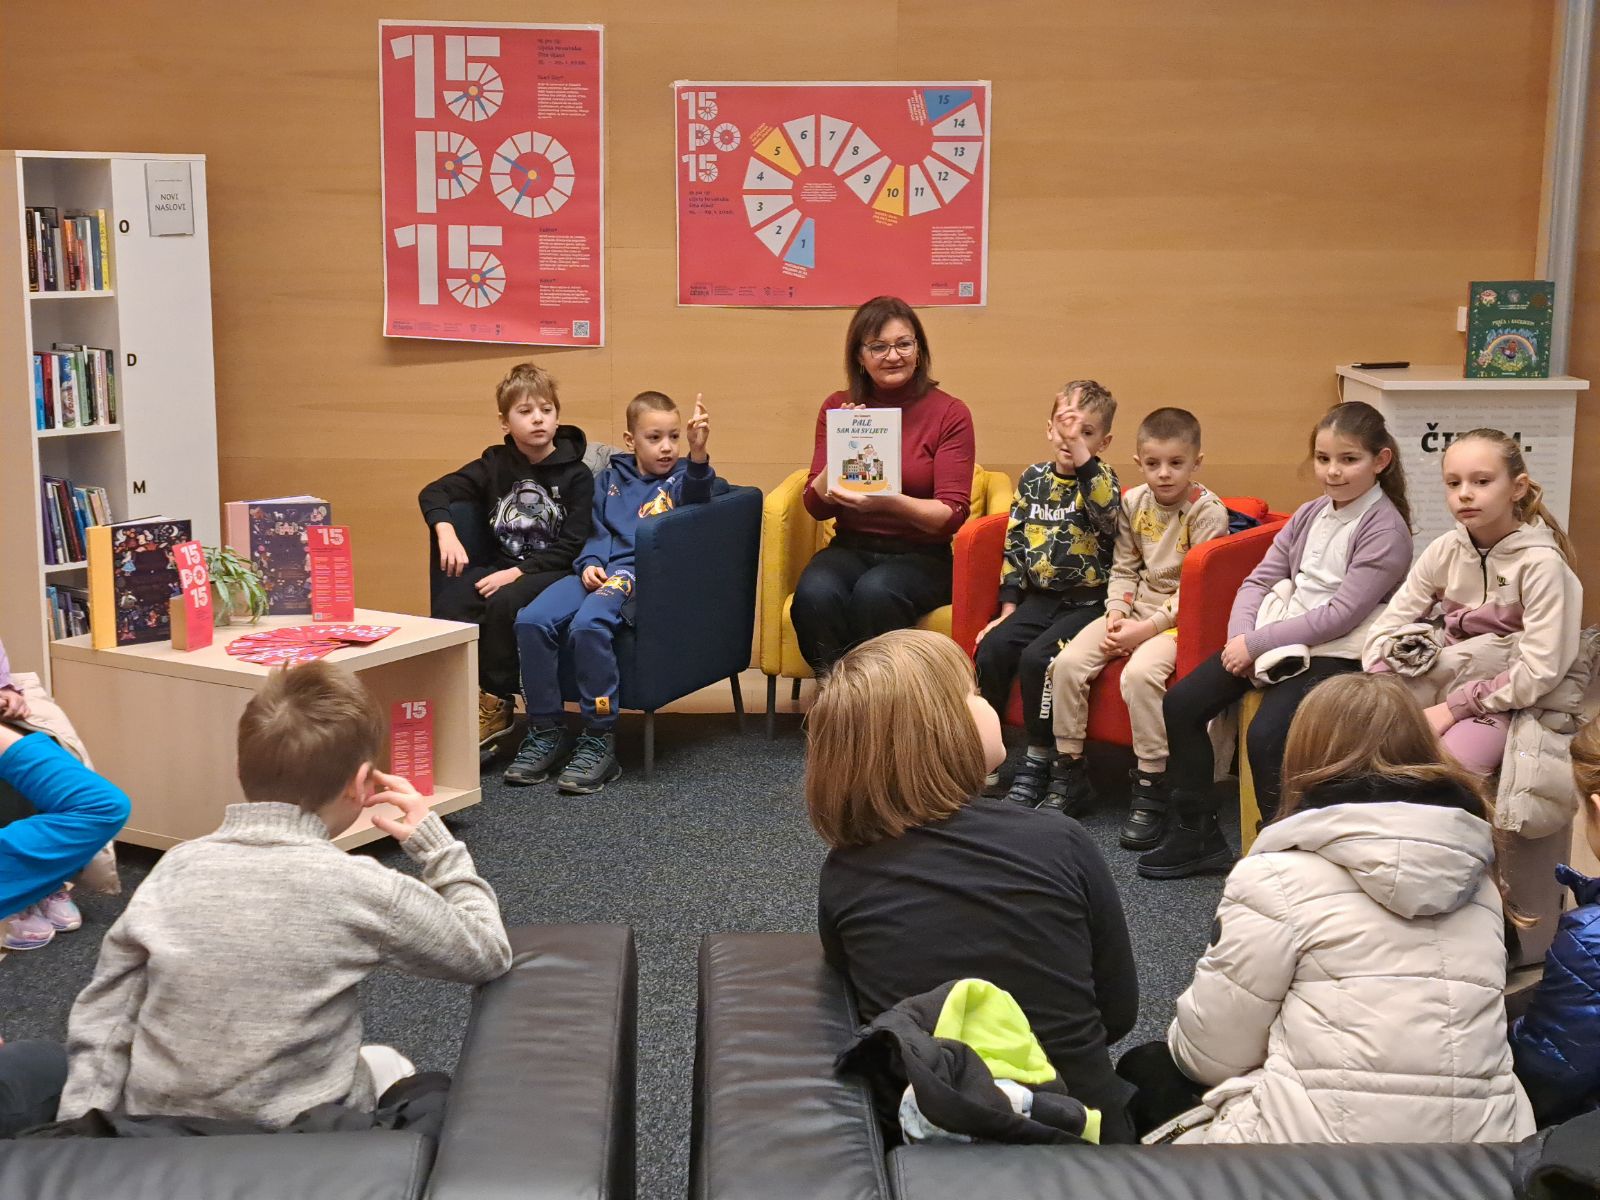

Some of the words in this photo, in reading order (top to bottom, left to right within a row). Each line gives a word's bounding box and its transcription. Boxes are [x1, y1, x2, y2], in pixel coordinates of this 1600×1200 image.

[390, 34, 504, 122] 15
[938, 94, 950, 104] 15
[681, 91, 719, 121] 15
[953, 118, 965, 128] 14
[800, 130, 808, 139] 6
[829, 131, 836, 140] 7
[774, 146, 781, 156] 5
[852, 146, 859, 155] 8
[954, 147, 965, 156] 13
[682, 154, 719, 183] 15
[415, 131, 575, 218] PO
[756, 172, 764, 181] 4
[863, 174, 871, 184] 9
[937, 171, 949, 181] 12
[887, 188, 899, 198] 10
[914, 187, 924, 197] 11
[154, 203, 186, 211] NASLOVI
[756, 202, 764, 211] 3
[119, 219, 130, 234] O
[775, 225, 782, 235] 2
[801, 239, 806, 248] 1
[393, 224, 506, 308] 15
[127, 353, 137, 366] D
[852, 418, 872, 426] PALE
[133, 480, 146, 494] M
[317, 528, 344, 545] 15
[180, 544, 200, 566] 15
[190, 586, 209, 608] 15
[401, 701, 427, 720] 15
